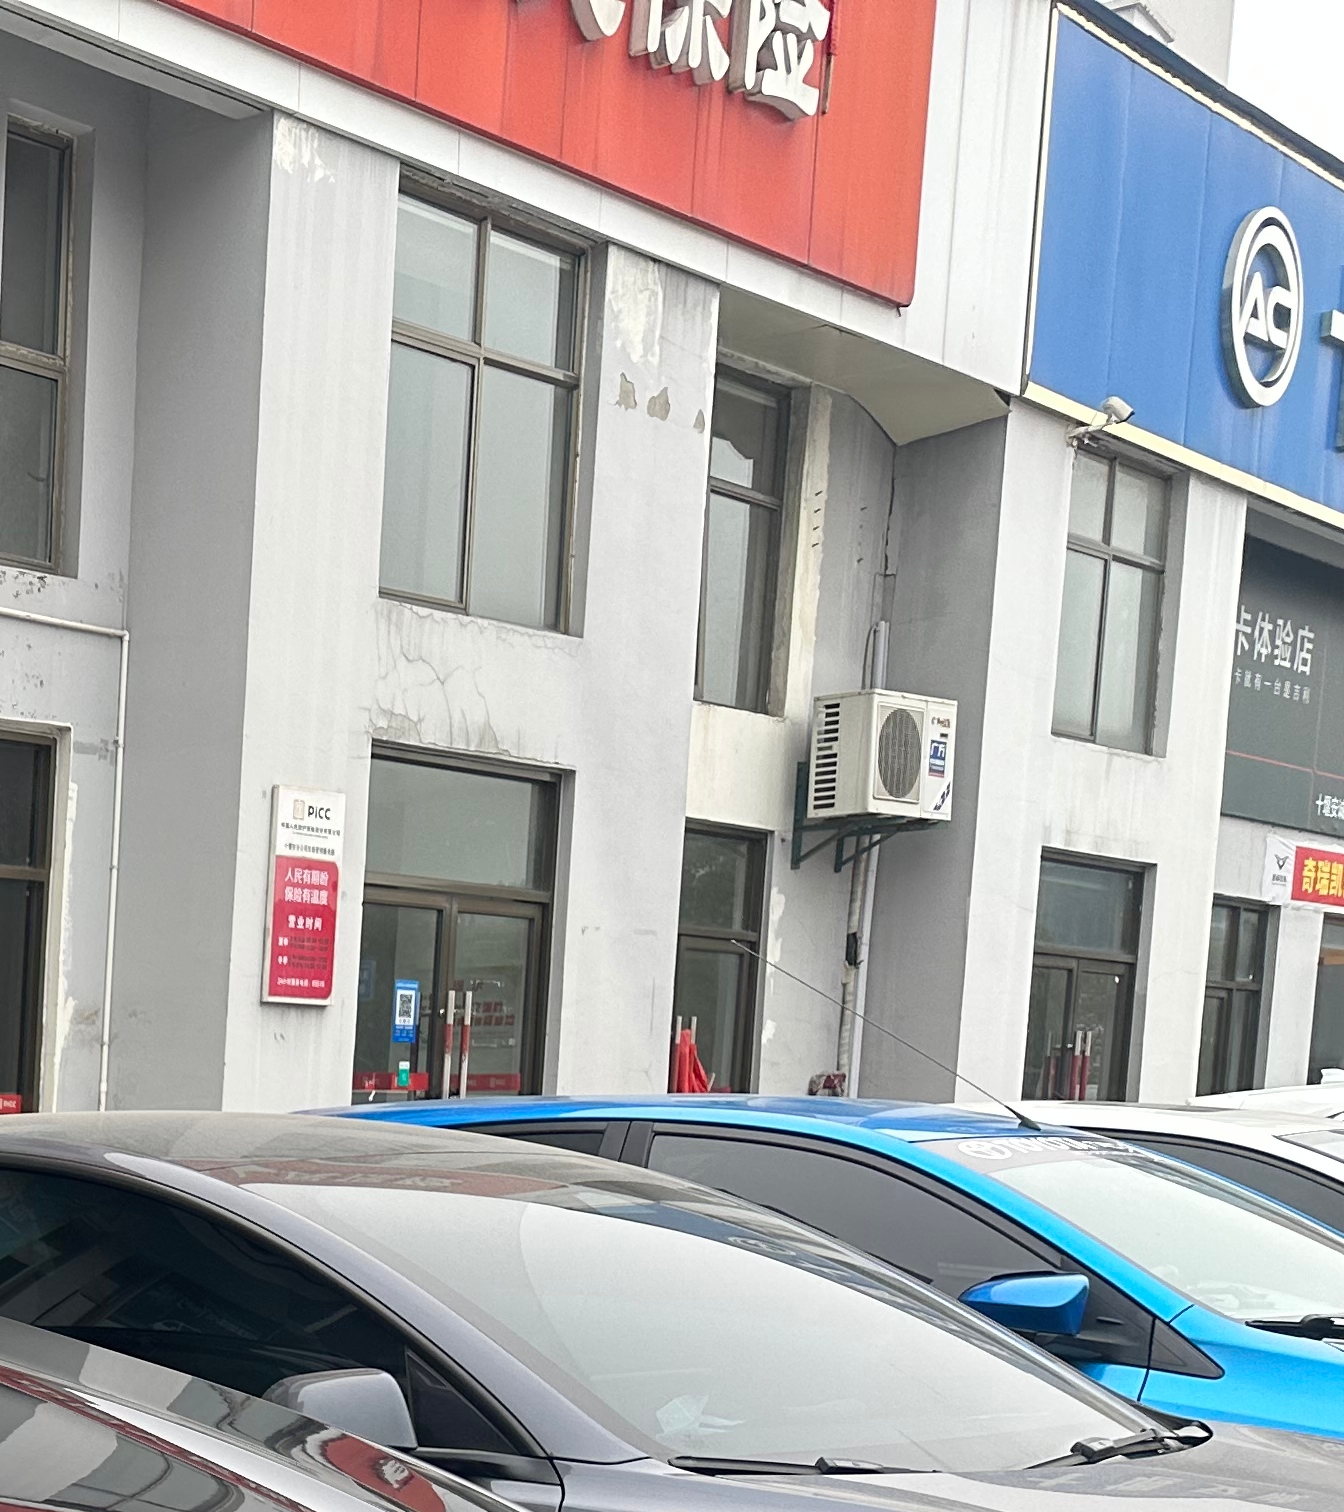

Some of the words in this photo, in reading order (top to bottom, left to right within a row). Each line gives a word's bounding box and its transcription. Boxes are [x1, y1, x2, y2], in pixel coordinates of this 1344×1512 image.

[307, 805, 331, 820] PICC
[1301, 857, 1344, 899] 奇瑞凯
[288, 914, 323, 932] 营业时间
